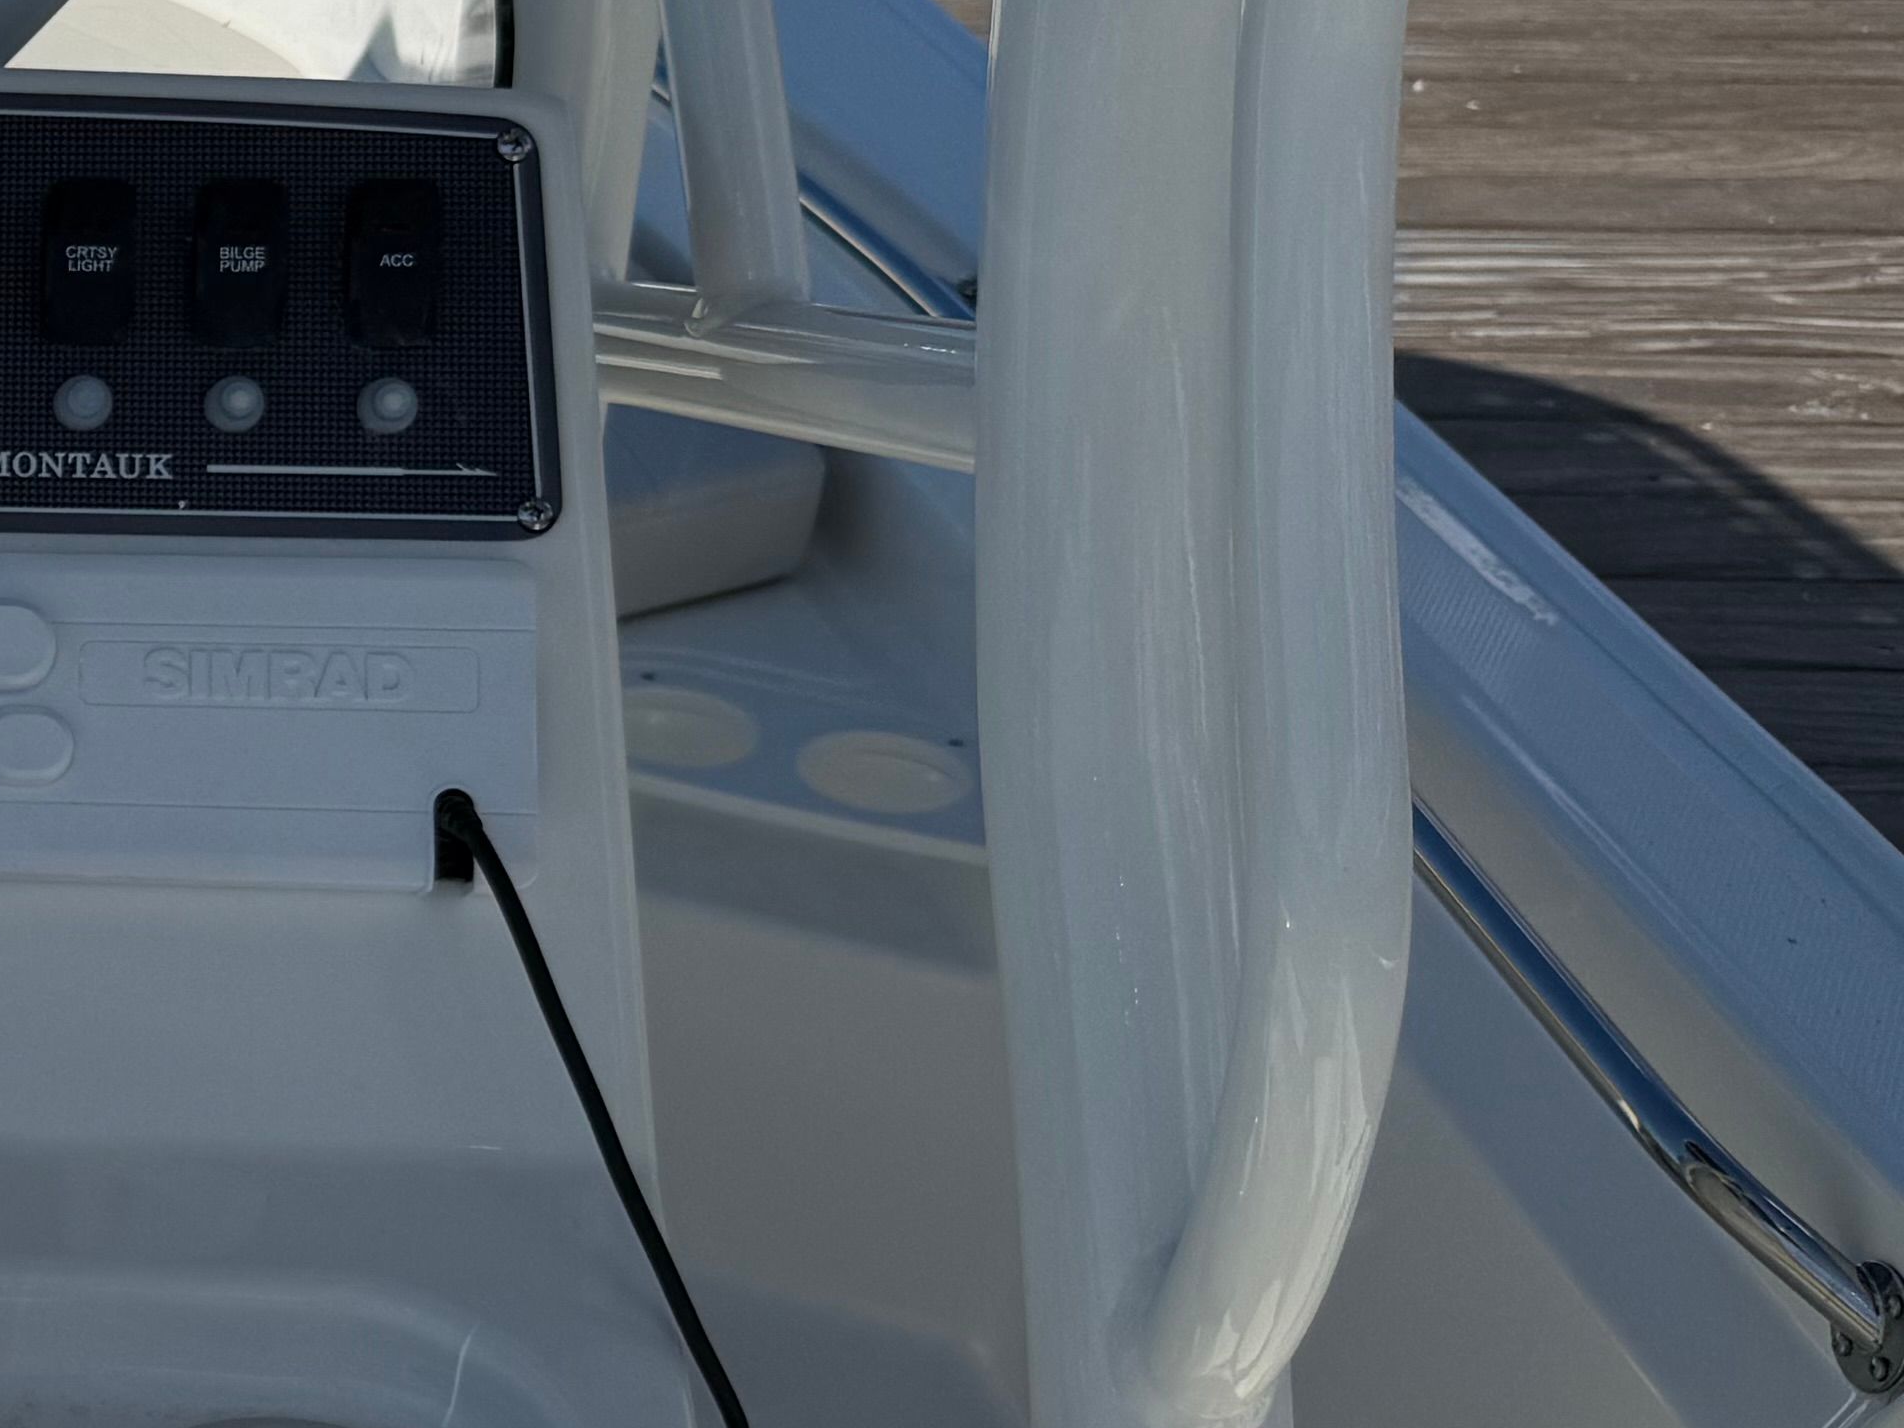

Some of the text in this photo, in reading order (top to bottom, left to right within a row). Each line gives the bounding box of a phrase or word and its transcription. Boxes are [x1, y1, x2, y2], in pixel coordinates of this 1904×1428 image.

[65, 244, 119, 260] CRTSY
[219, 245, 266, 261] BILGE
[68, 259, 114, 274] LIGHT
[219, 259, 266, 274] PUMP
[379, 253, 414, 269] ACC
[141, 644, 414, 704] SIMRAD
